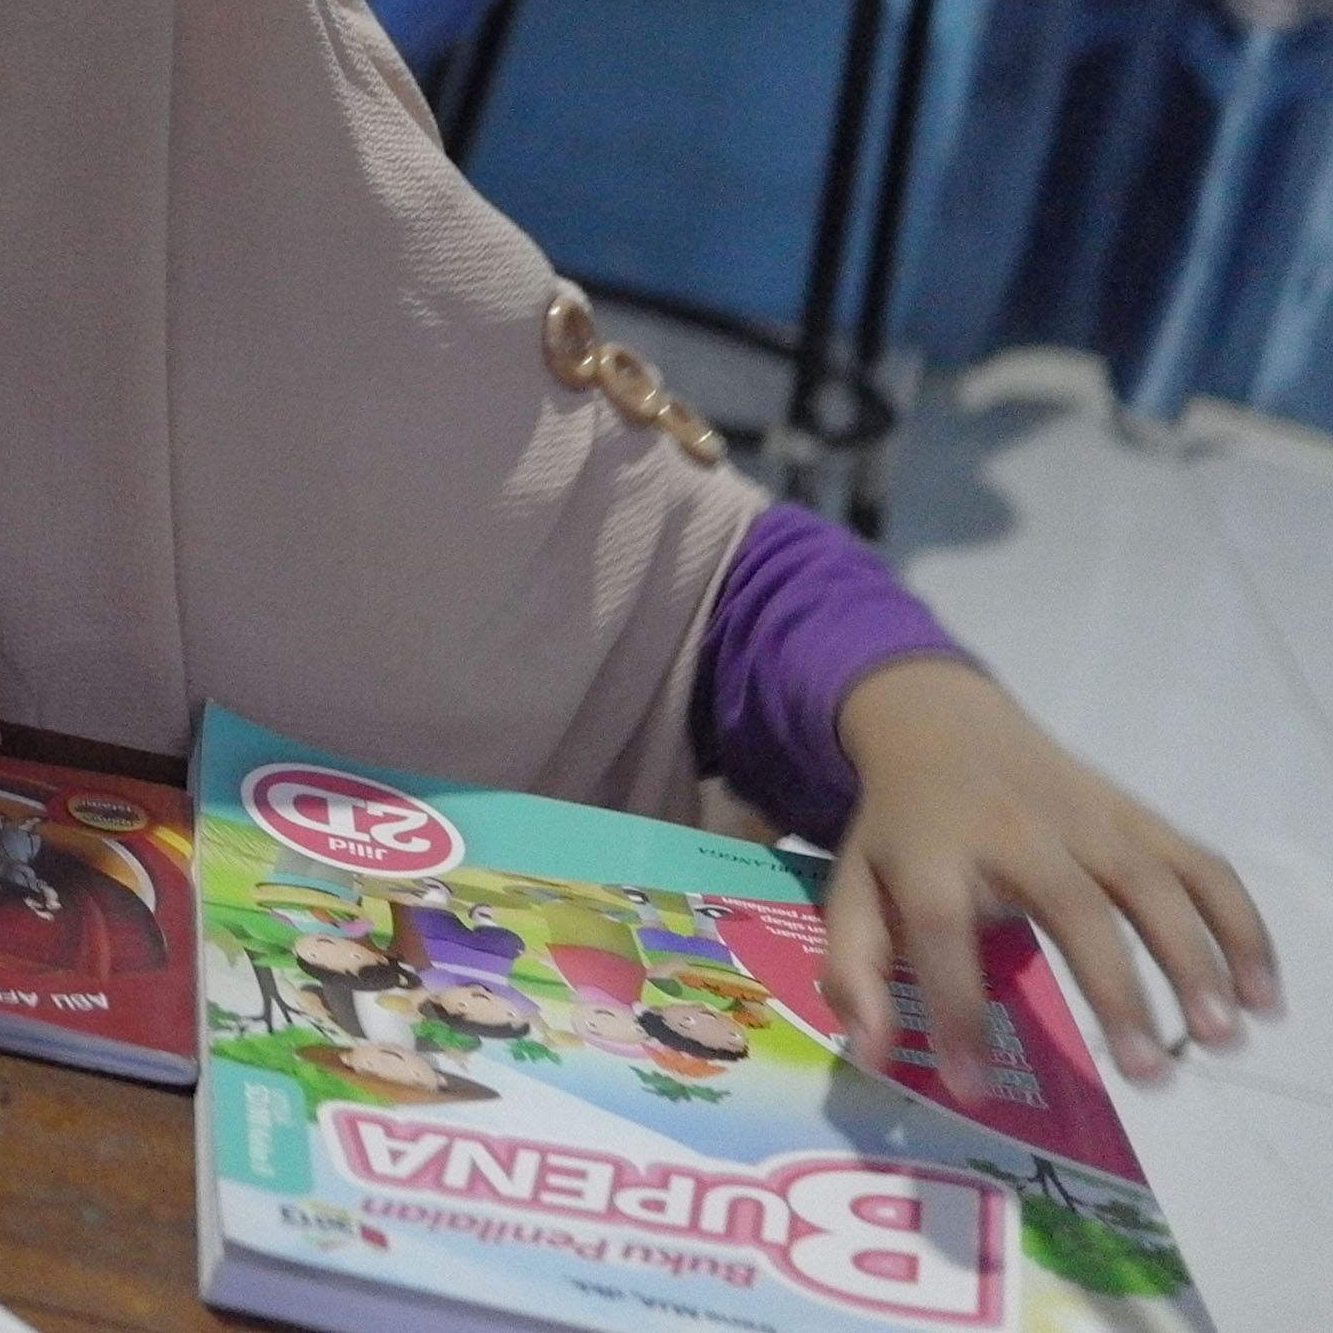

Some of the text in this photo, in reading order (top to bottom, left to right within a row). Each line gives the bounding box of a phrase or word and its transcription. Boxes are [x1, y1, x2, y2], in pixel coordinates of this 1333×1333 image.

[266, 781, 430, 854] 2D
[328, 836, 387, 860] Jilid
[721, 896, 798, 918] penilaian
[760, 915, 806, 931] sikap
[49, 992, 109, 1011] ABU
[359, 1120, 980, 1316] BUPENA
[360, 1196, 756, 1290] Buku Penilaian
